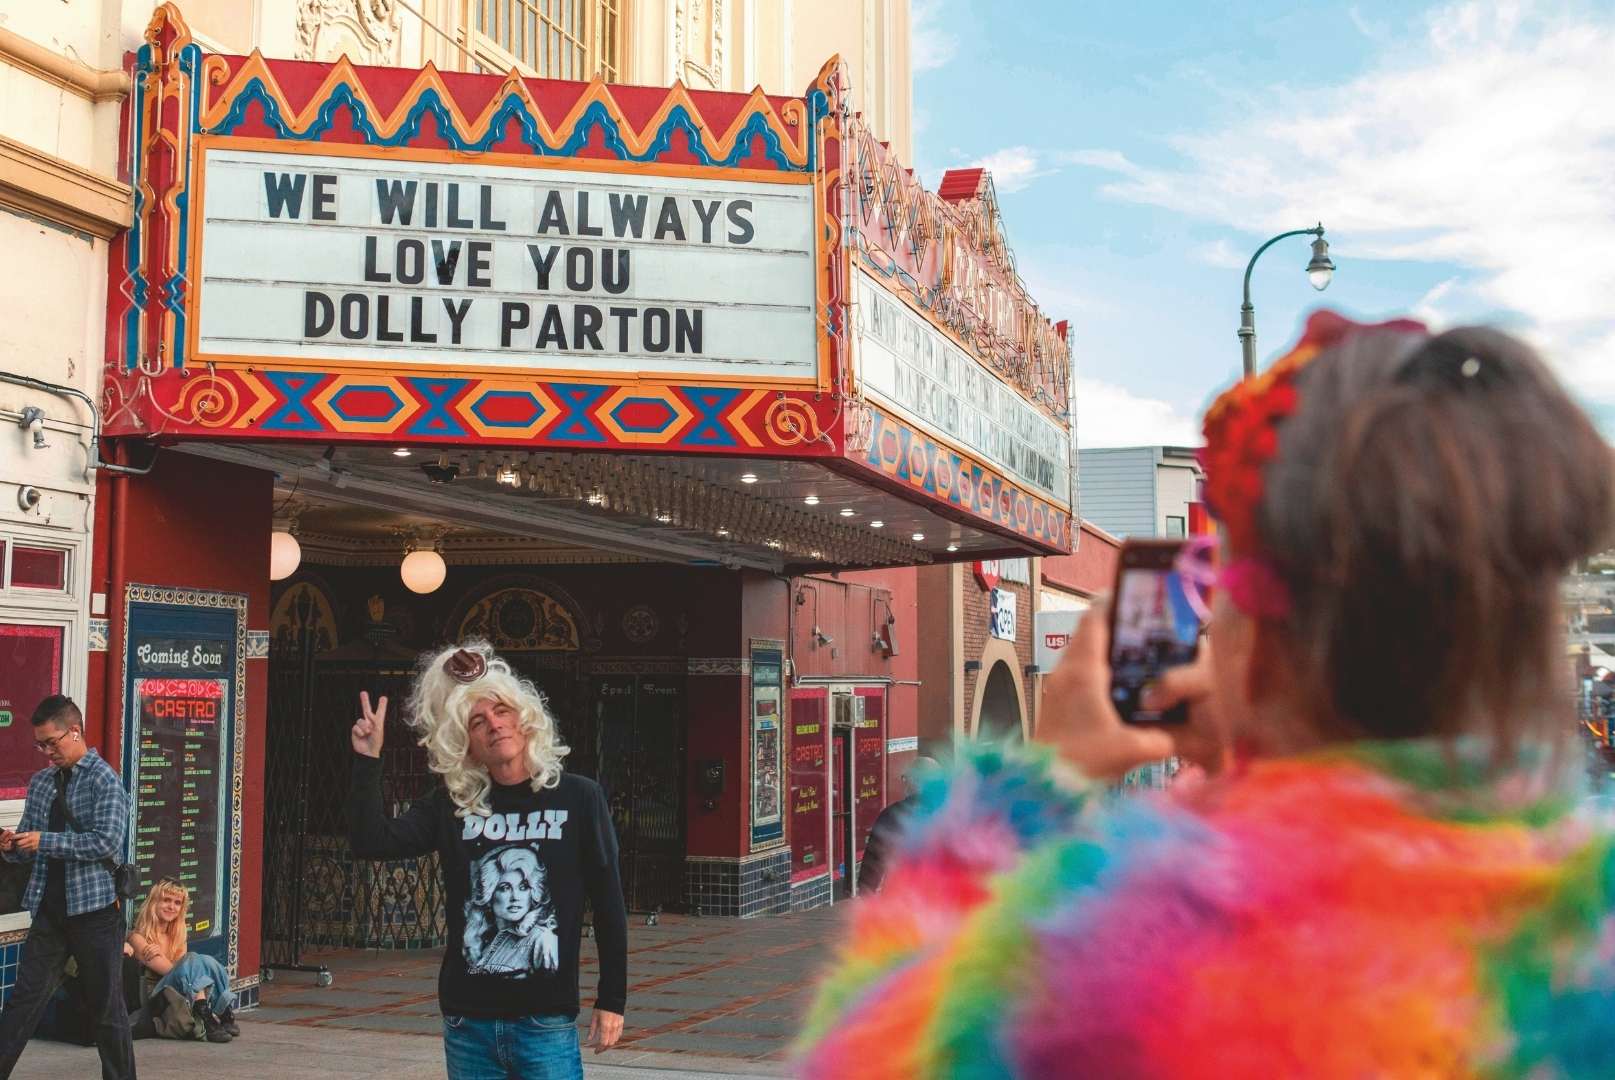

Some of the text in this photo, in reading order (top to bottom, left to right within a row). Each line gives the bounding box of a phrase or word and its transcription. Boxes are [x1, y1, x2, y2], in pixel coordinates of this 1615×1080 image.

[264, 172, 755, 244] WE WILL ALWAYS
[364, 235, 630, 294] LOVE YOU
[304, 291, 703, 354] DOLLY PARTON
[999, 607, 1015, 635] OPEN
[1047, 637, 1064, 647] us
[137, 644, 222, 668] Coming Soon
[154, 699, 215, 718] CASTRO
[796, 744, 822, 762] CASTRO
[859, 738, 880, 752] CASTRO
[462, 809, 568, 841] DOLLY
